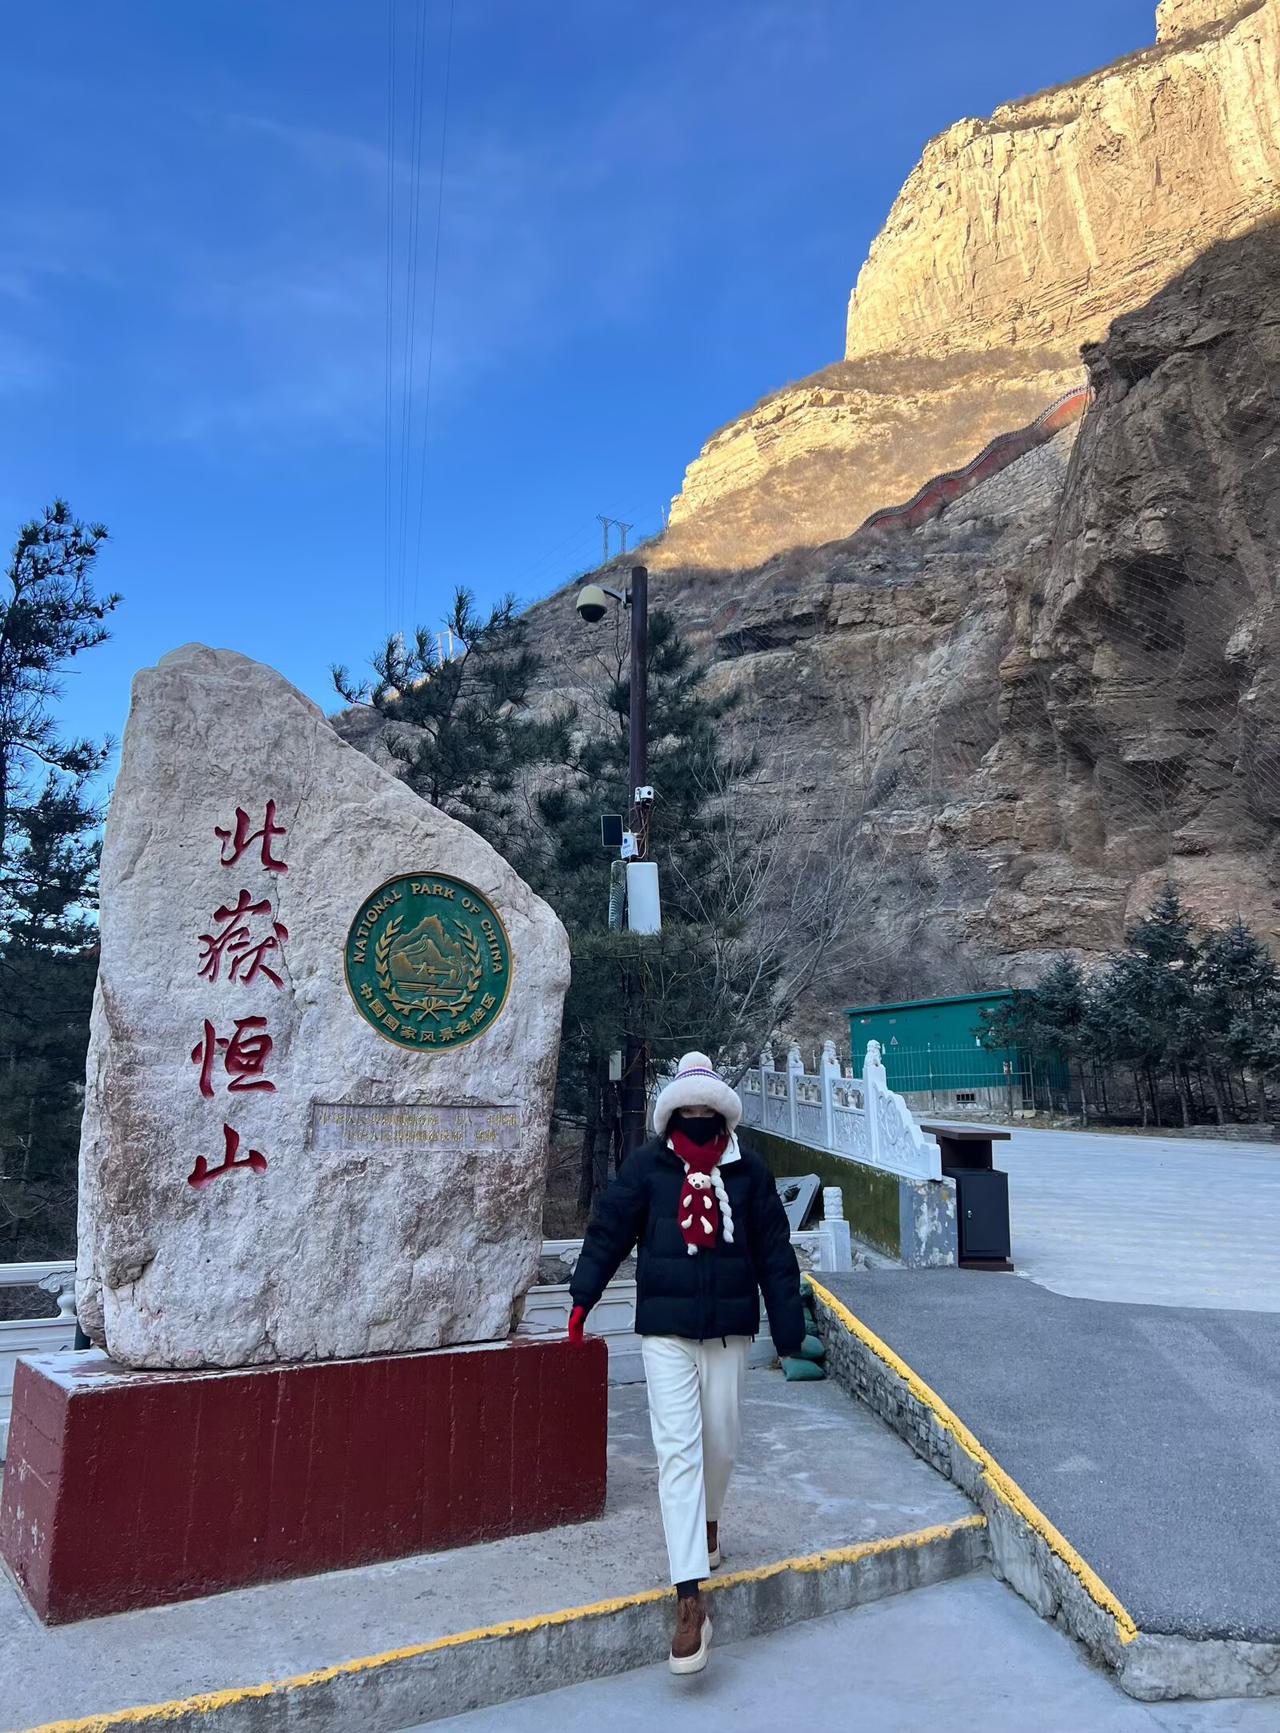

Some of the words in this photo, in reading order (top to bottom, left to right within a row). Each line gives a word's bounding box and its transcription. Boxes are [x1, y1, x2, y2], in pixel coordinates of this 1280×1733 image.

[353, 889, 403, 964] NATIONAL
[411, 883, 456, 899] PARK
[462, 897, 481, 915] OF
[481, 919, 504, 973] CHINA
[359, 982, 497, 1043] 中国国家风景名胜区
